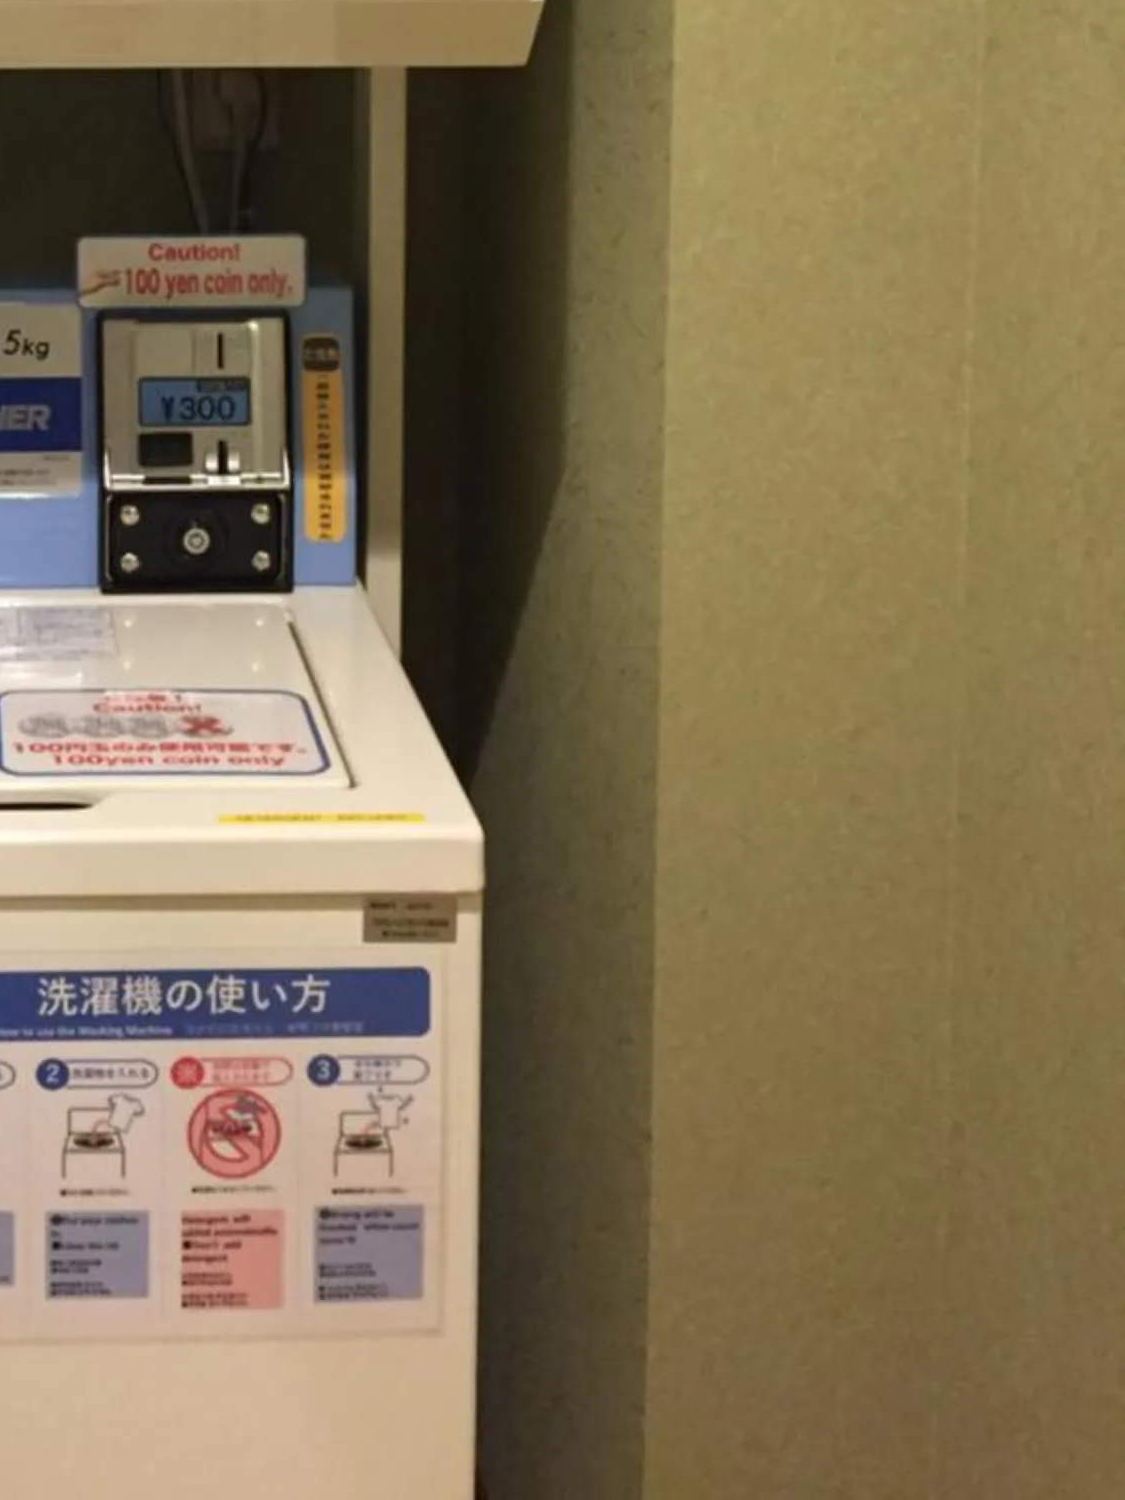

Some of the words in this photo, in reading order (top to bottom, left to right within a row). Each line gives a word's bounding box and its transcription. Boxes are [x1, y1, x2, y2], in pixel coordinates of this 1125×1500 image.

[146, 242, 241, 263] Caution!
[125, 268, 161, 296] 100
[164, 274, 200, 300] yen
[203, 269, 245, 296] coin
[247, 268, 294, 299] only.
[2, 330, 51, 361] 5kg
[161, 754, 220, 766] coin
[226, 754, 286, 767] only
[36, 973, 332, 1018] 洗濯機の使い方
[44, 1064, 61, 1084] 2
[316, 1062, 331, 1080] 3
